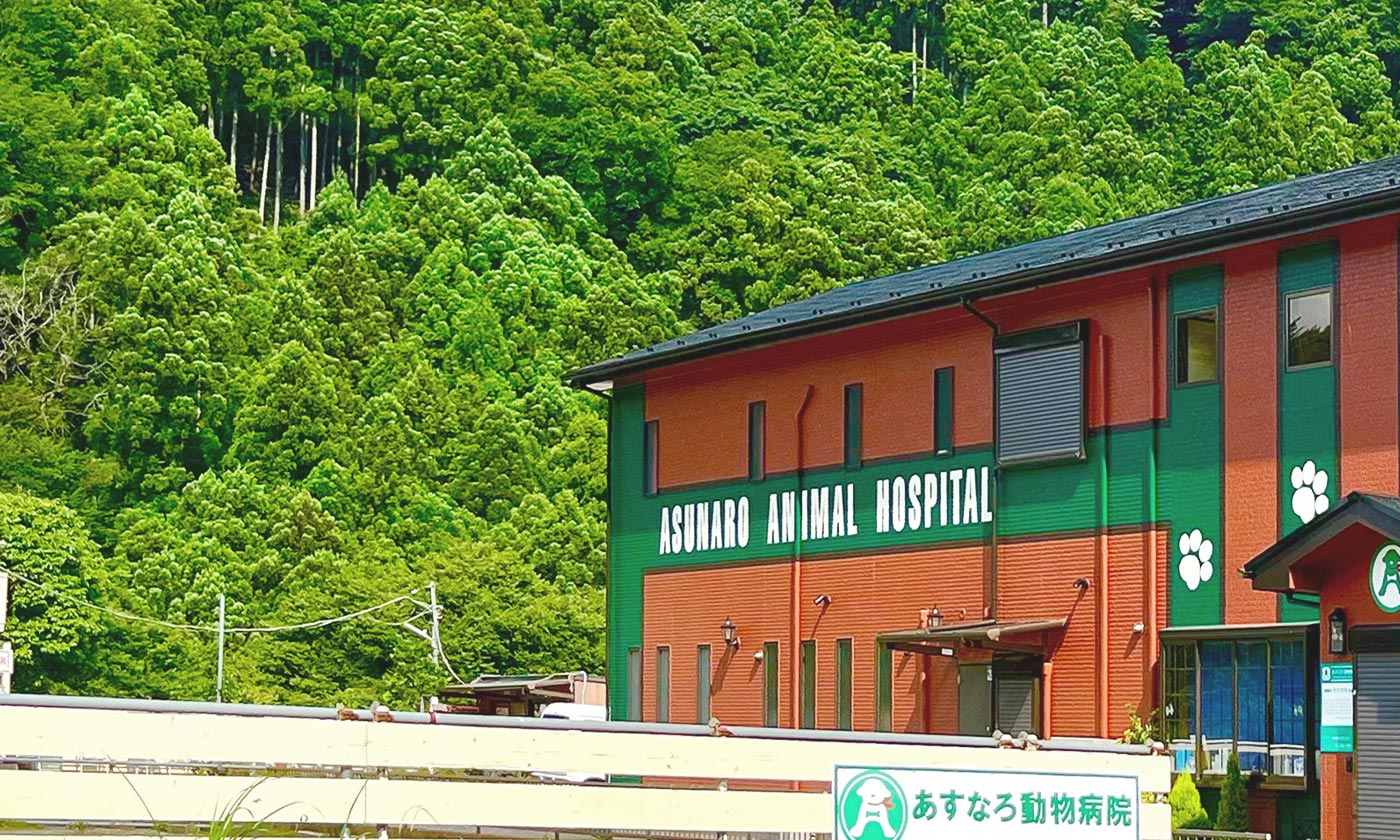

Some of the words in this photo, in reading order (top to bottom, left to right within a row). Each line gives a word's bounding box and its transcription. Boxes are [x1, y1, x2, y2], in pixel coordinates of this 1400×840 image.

[660, 497, 750, 554] ASUNARO
[767, 484, 858, 544] ANIMAL
[877, 466, 992, 532] HOSPITAL
[912, 788, 1131, 826] あすなろ動物病院
